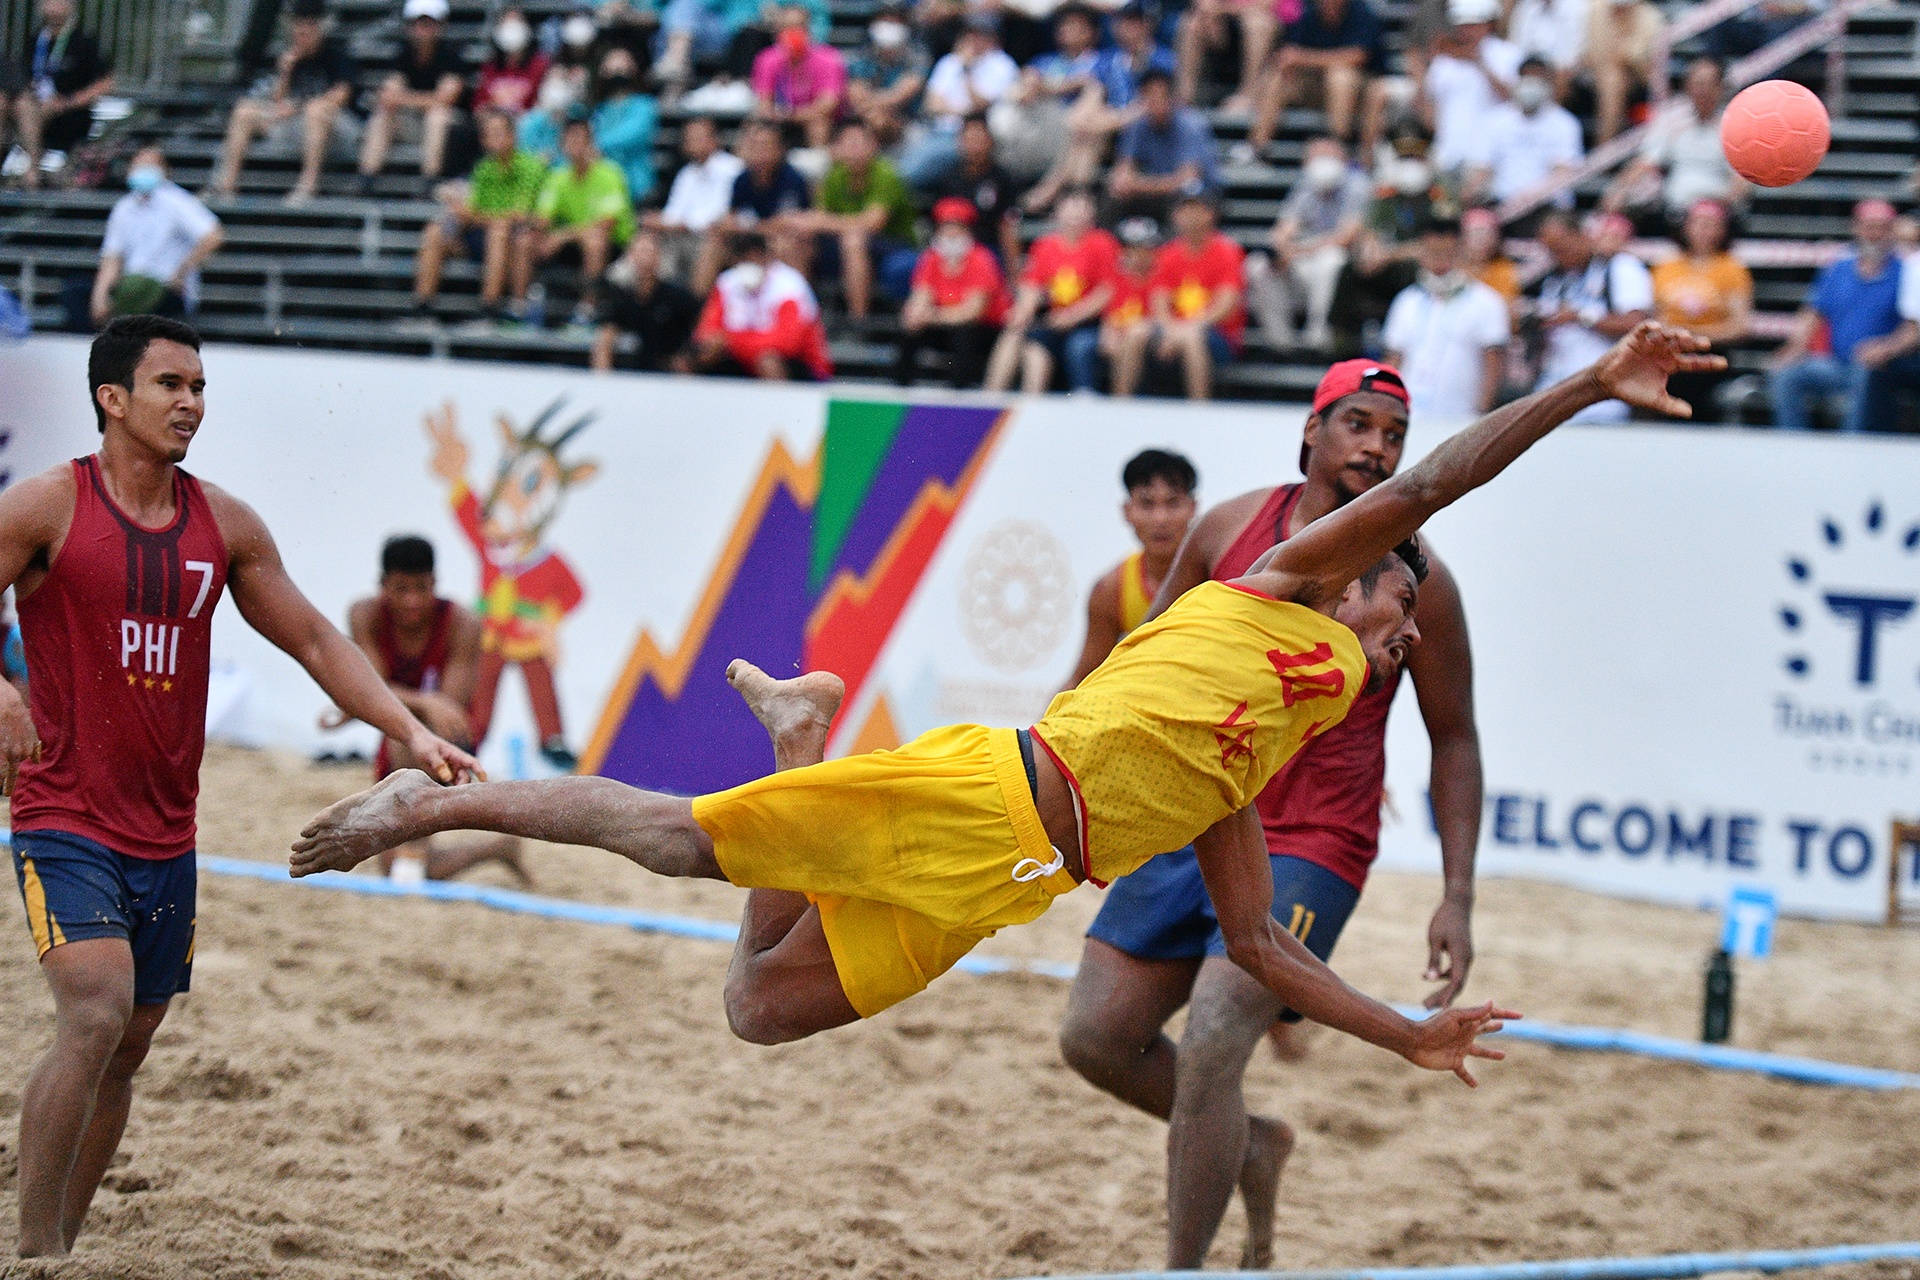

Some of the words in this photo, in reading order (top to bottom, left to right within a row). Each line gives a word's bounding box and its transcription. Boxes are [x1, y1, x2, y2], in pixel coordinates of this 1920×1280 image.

[185, 560, 214, 618] 7
[121, 618, 180, 675] PHI
[1266, 642, 1345, 708] 10
[1424, 788, 1760, 868] ELCOME
[1786, 821, 1874, 879] TO
[1288, 903, 1316, 944] 11
